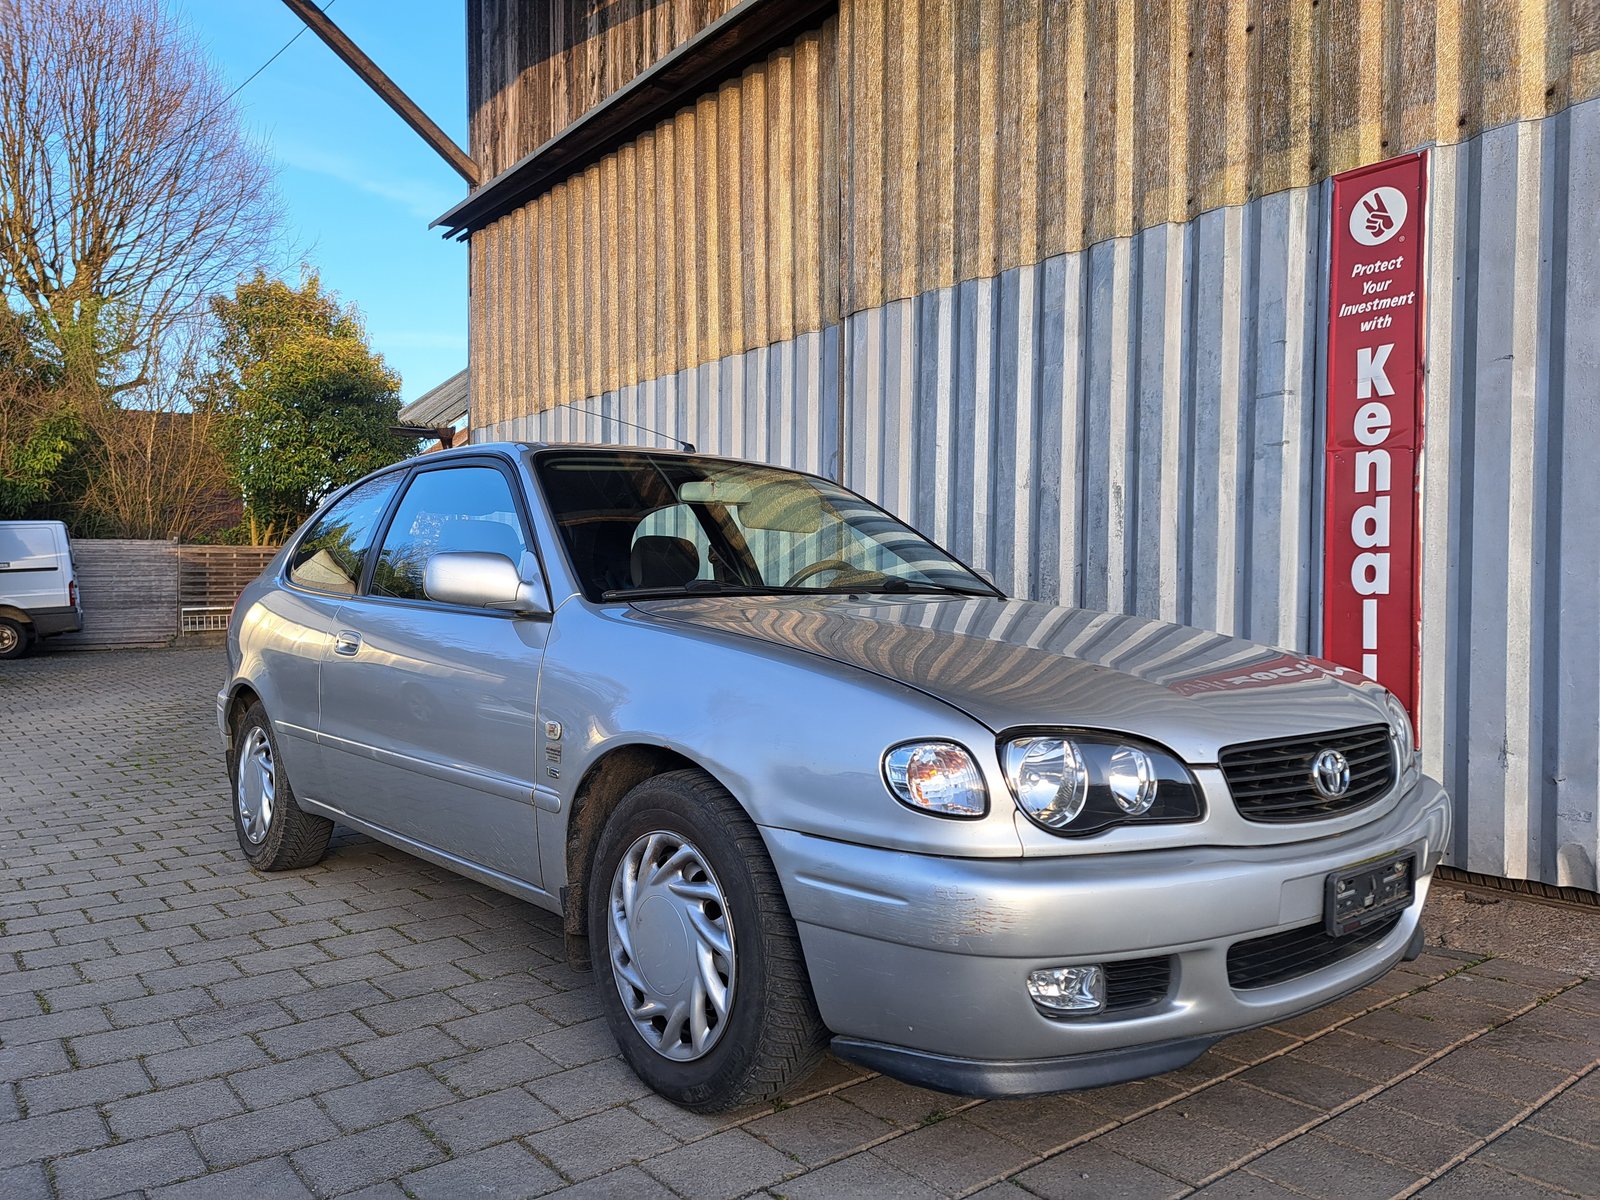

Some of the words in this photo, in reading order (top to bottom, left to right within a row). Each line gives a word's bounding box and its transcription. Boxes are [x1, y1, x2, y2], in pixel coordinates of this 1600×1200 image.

[1352, 256, 1404, 277] Protect
[1362, 279, 1392, 296] Your
[1339, 291, 1415, 318] Investment
[1360, 314, 1392, 333] with
